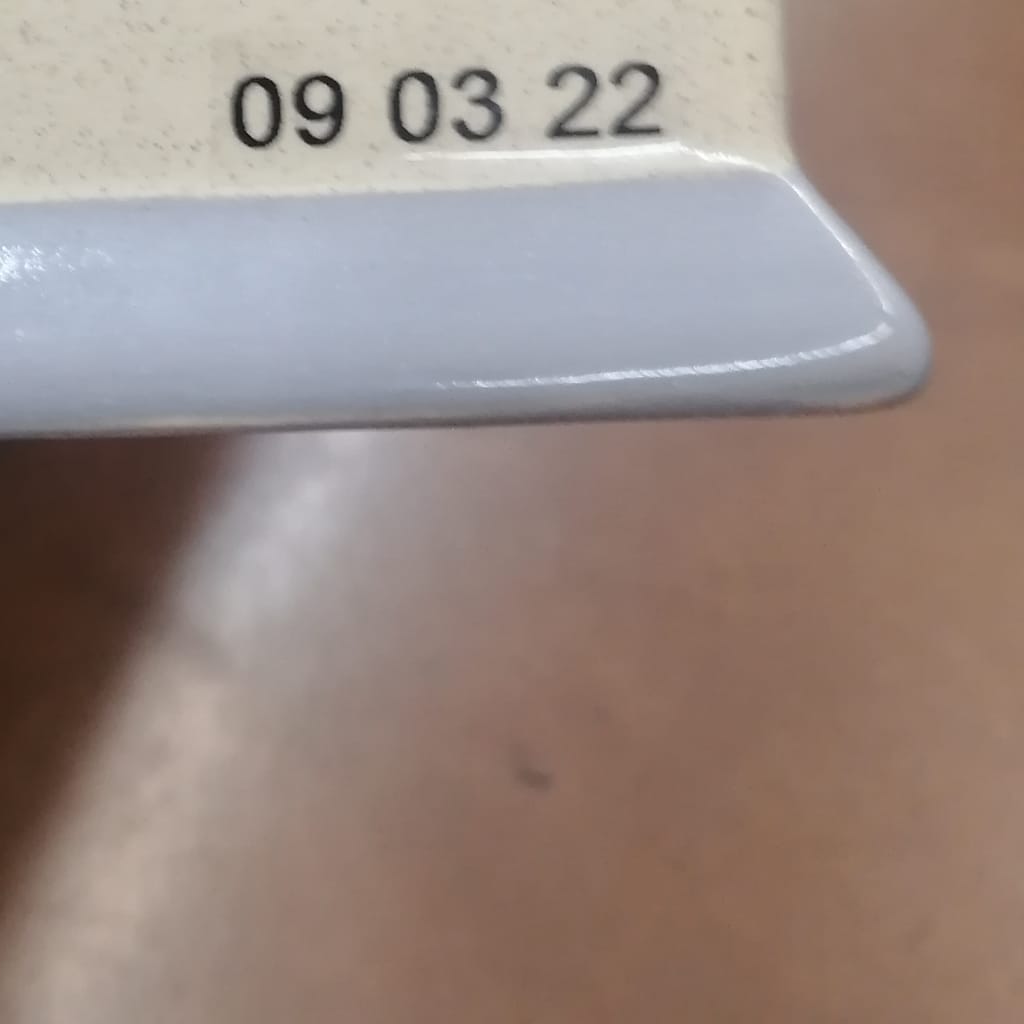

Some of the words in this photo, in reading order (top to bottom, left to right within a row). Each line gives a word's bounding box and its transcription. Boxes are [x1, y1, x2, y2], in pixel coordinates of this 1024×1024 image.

[231, 73, 346, 148] 09
[390, 67, 504, 143] 03
[545, 61, 663, 139] 22
